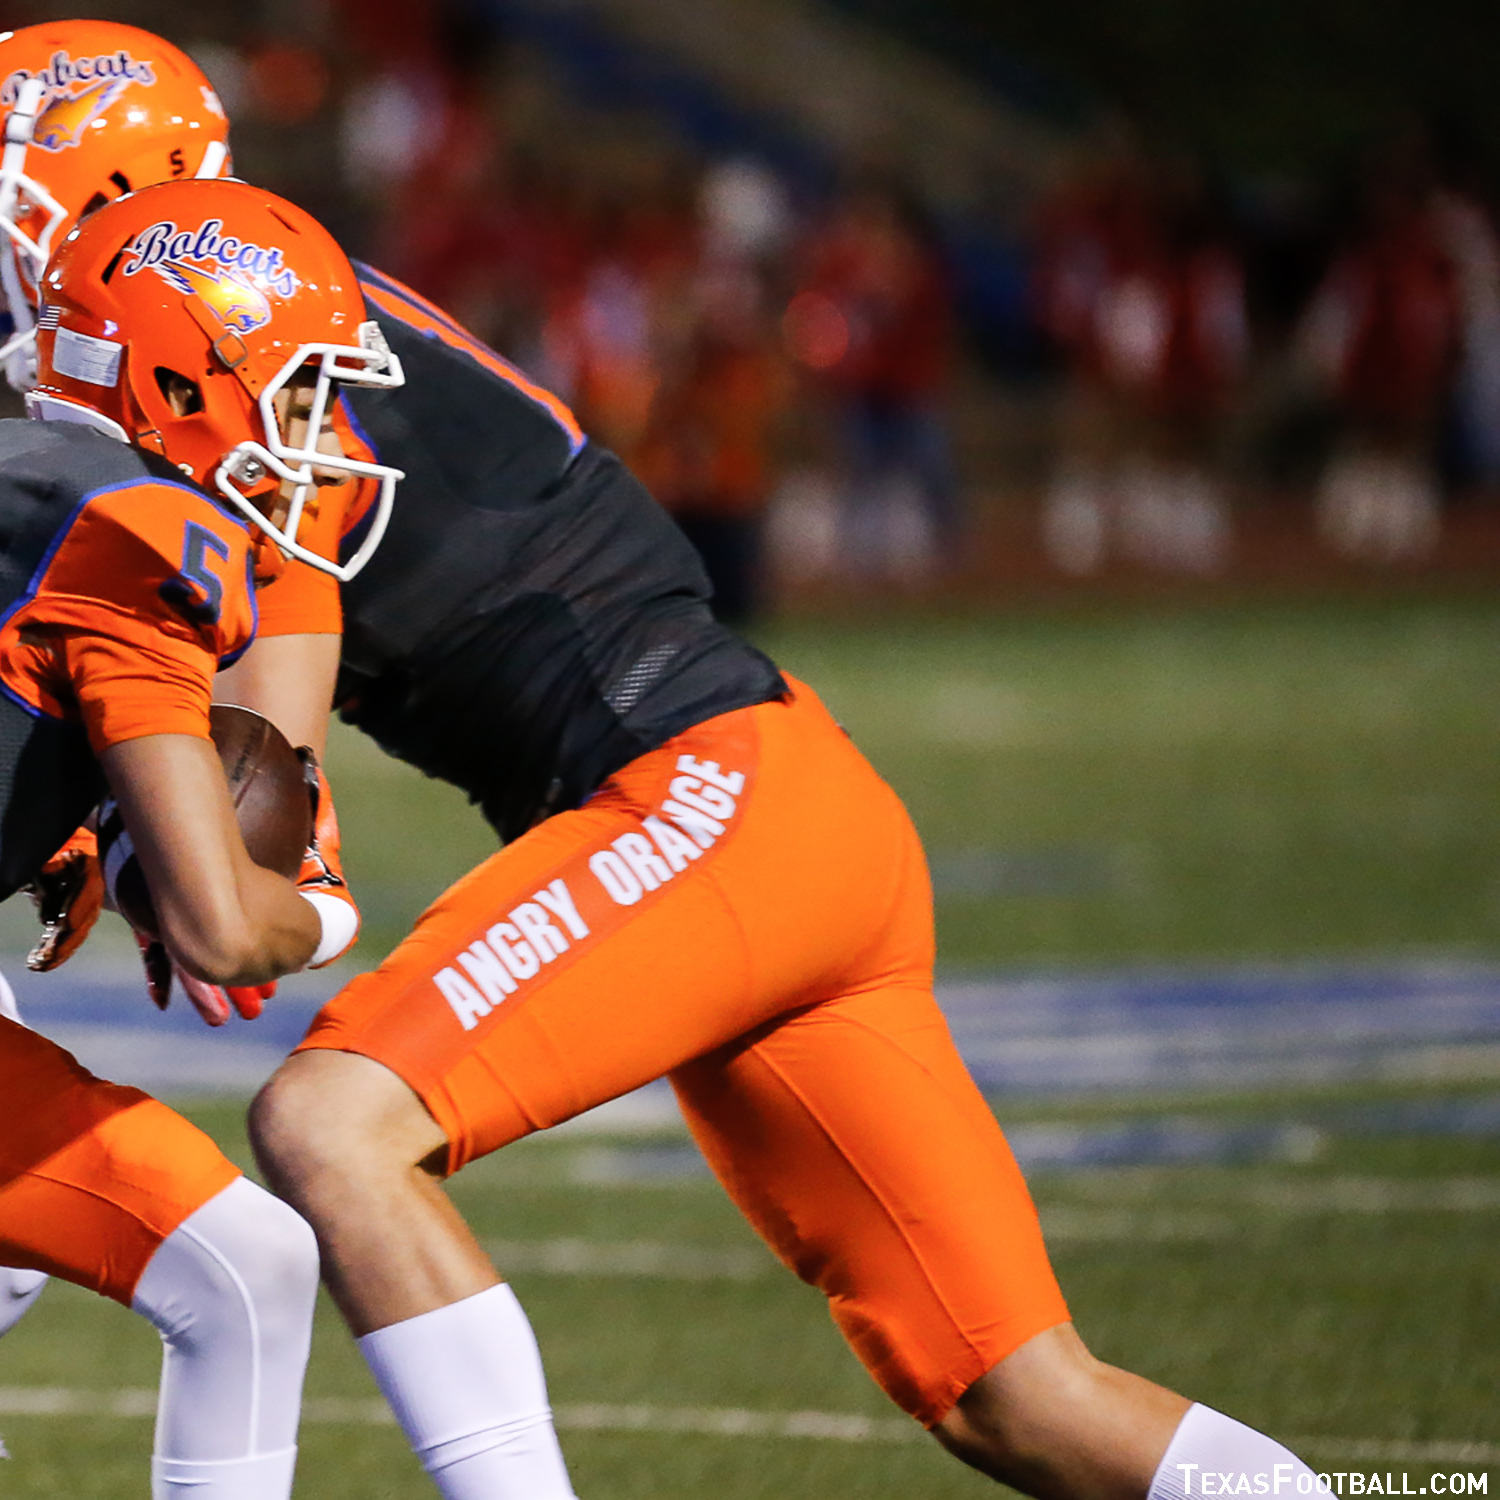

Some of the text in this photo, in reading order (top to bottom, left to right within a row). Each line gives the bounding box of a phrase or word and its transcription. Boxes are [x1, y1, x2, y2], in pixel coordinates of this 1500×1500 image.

[123, 219, 297, 299] Bobcats
[157, 519, 230, 626] 5
[433, 754, 746, 1031] ANGRY ORANGE
